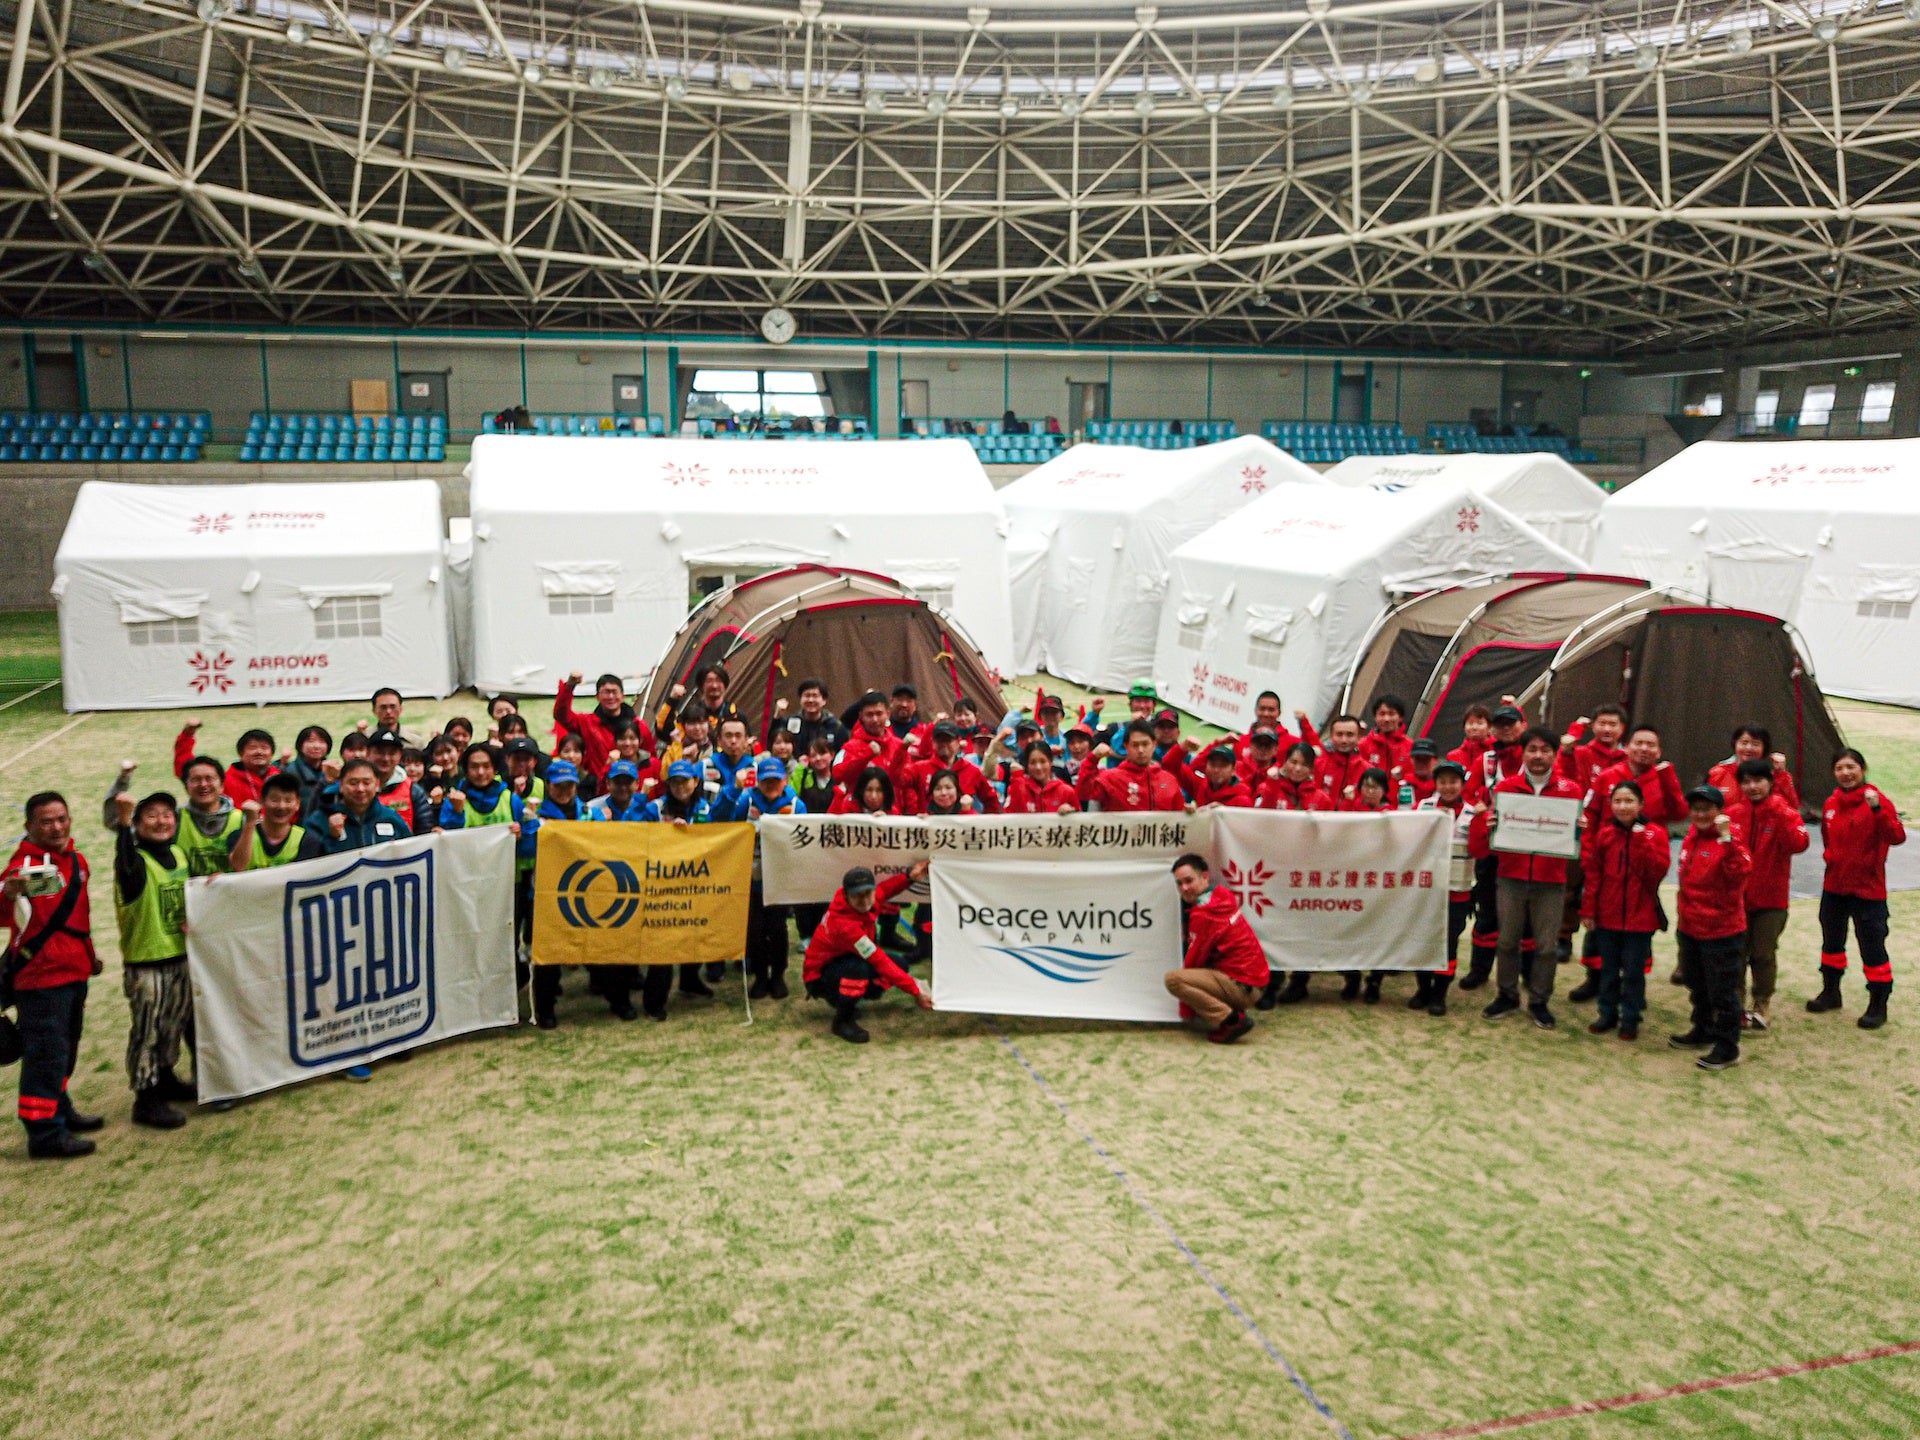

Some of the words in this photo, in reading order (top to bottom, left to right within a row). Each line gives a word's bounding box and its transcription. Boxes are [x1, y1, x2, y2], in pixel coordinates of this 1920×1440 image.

[248, 655, 329, 670] ARROWS
[789, 821, 1187, 851] 多機関連携災害時医療救助訓練
[645, 859, 711, 879] HuMA
[644, 883, 732, 898] Humanitarian
[644, 899, 693, 912] Medical
[1288, 898, 1364, 913] ARROWS
[641, 916, 709, 928] Assistance
[957, 902, 1048, 930] peace
[1057, 901, 1153, 930] winds
[998, 932, 1112, 944] JAPAN
[298, 873, 421, 1021] PEAD
[304, 1017, 353, 1037] Platform
[352, 1008, 365, 1024] of
[367, 997, 422, 1021] Emergency
